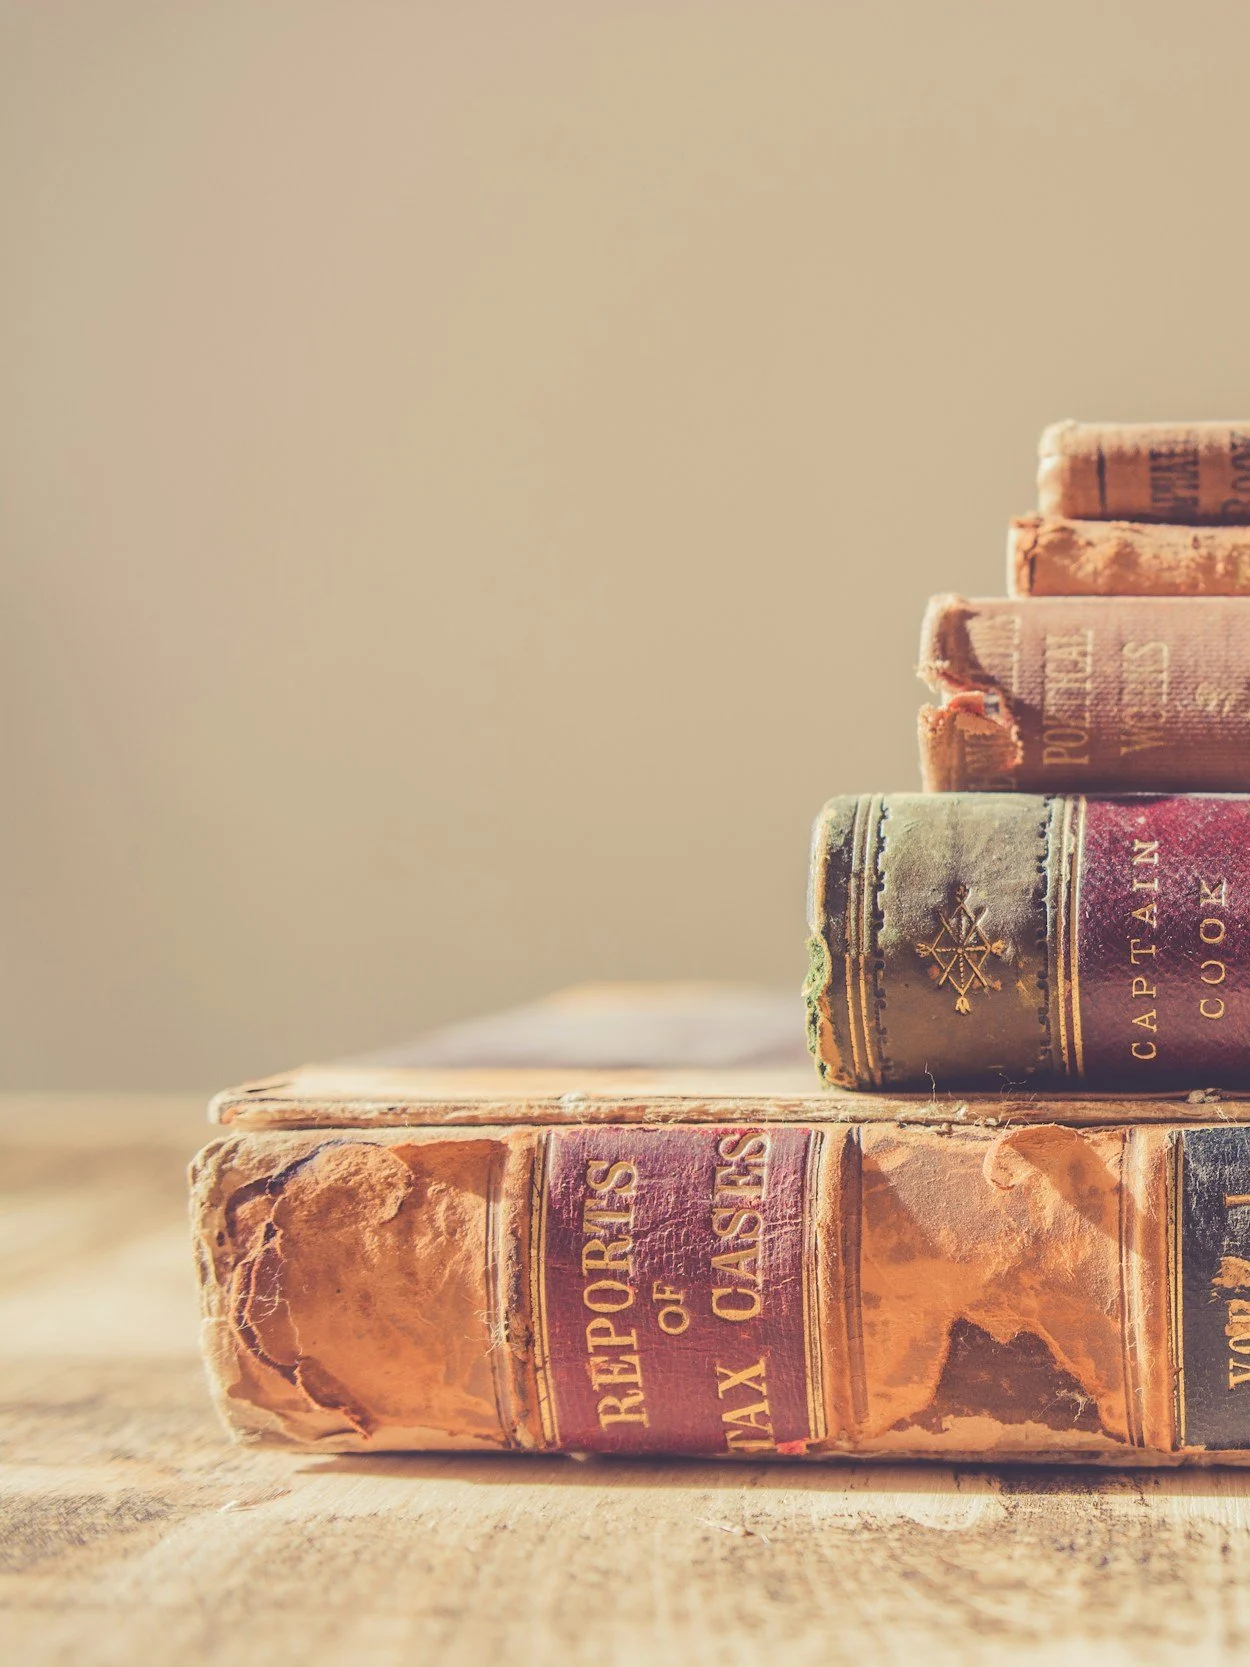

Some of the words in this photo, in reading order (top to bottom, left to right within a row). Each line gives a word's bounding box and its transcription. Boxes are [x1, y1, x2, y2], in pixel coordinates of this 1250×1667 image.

[1042, 629, 1093, 765] POETICAL
[1130, 839, 1159, 1060] CAPTAIN
[1199, 878, 1227, 1020] COOK
[582, 1159, 649, 1429] REPORTS
[710, 1130, 771, 1322] CASES
[653, 1281, 690, 1335] OF
[715, 1357, 777, 1454] TAX
